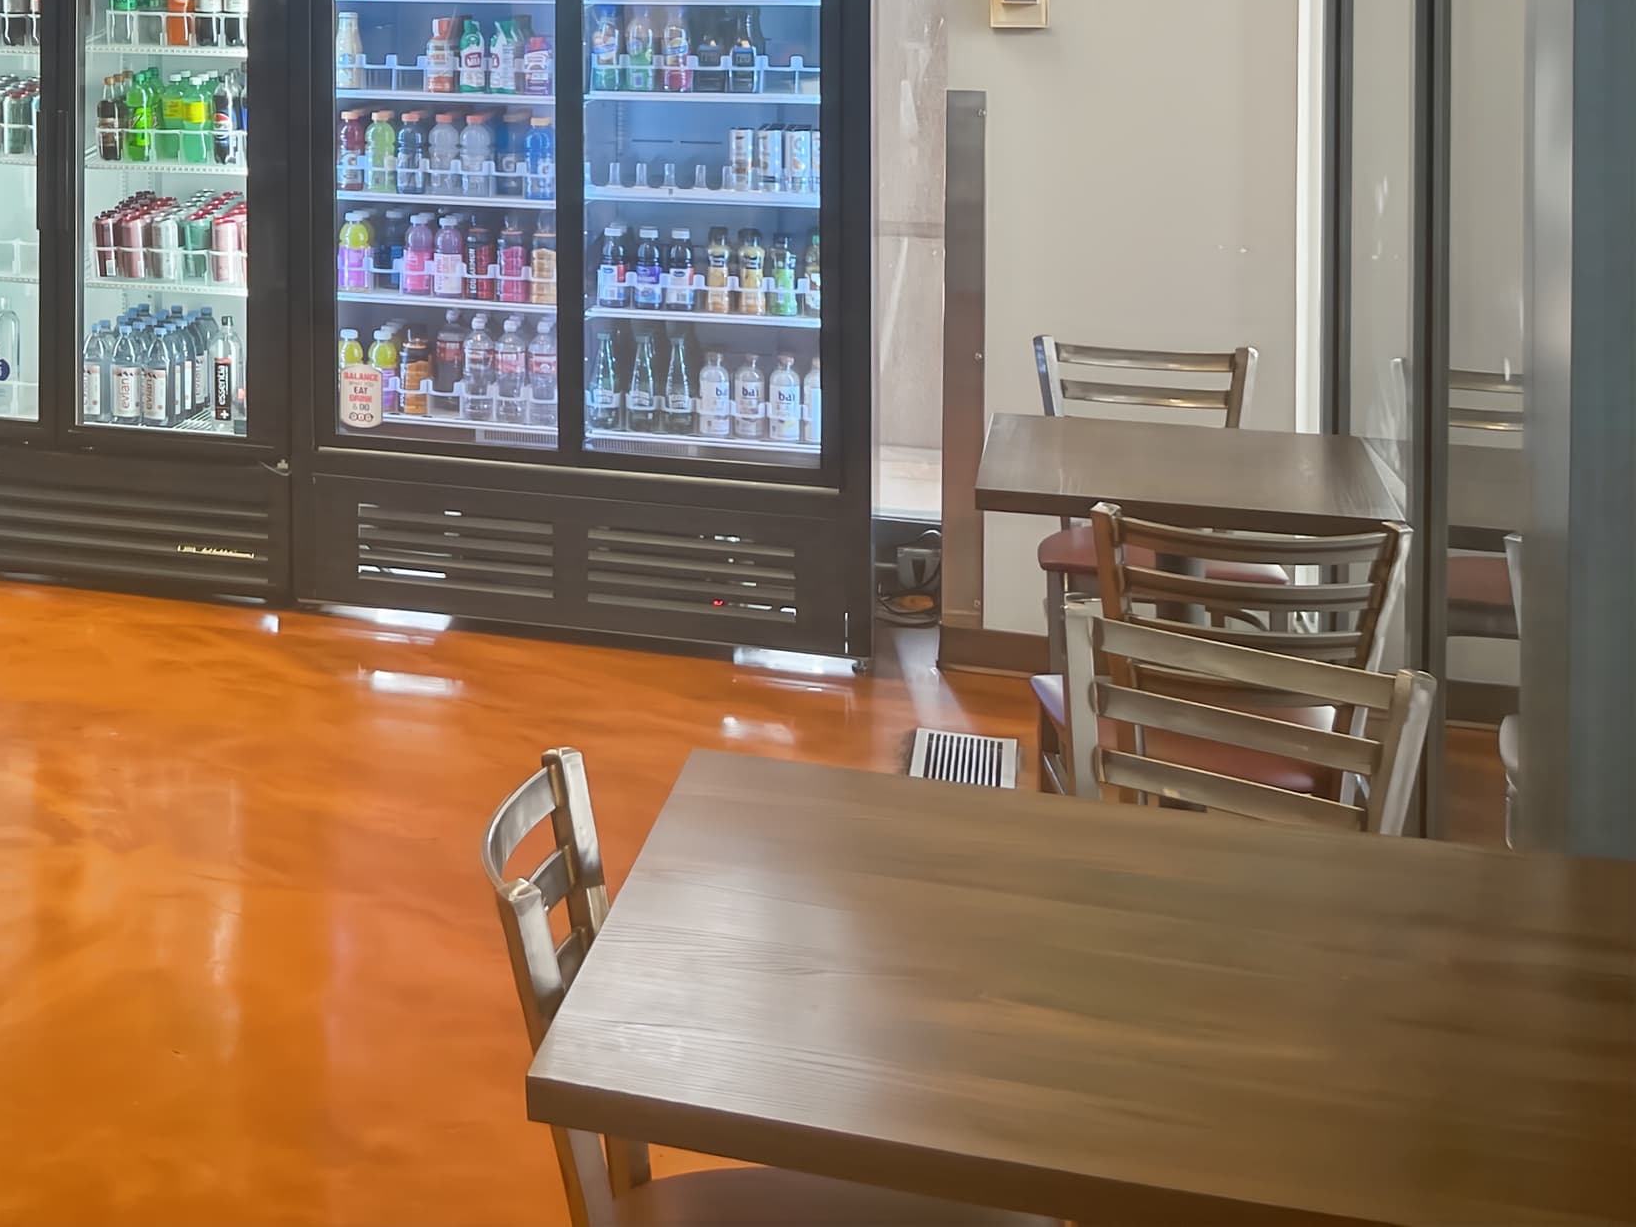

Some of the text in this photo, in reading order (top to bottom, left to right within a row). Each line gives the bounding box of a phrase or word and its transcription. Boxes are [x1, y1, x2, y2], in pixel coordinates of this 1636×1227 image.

[121, 376, 131, 409] evian
[217, 364, 229, 405] essentia
[353, 386, 368, 395] EAT
